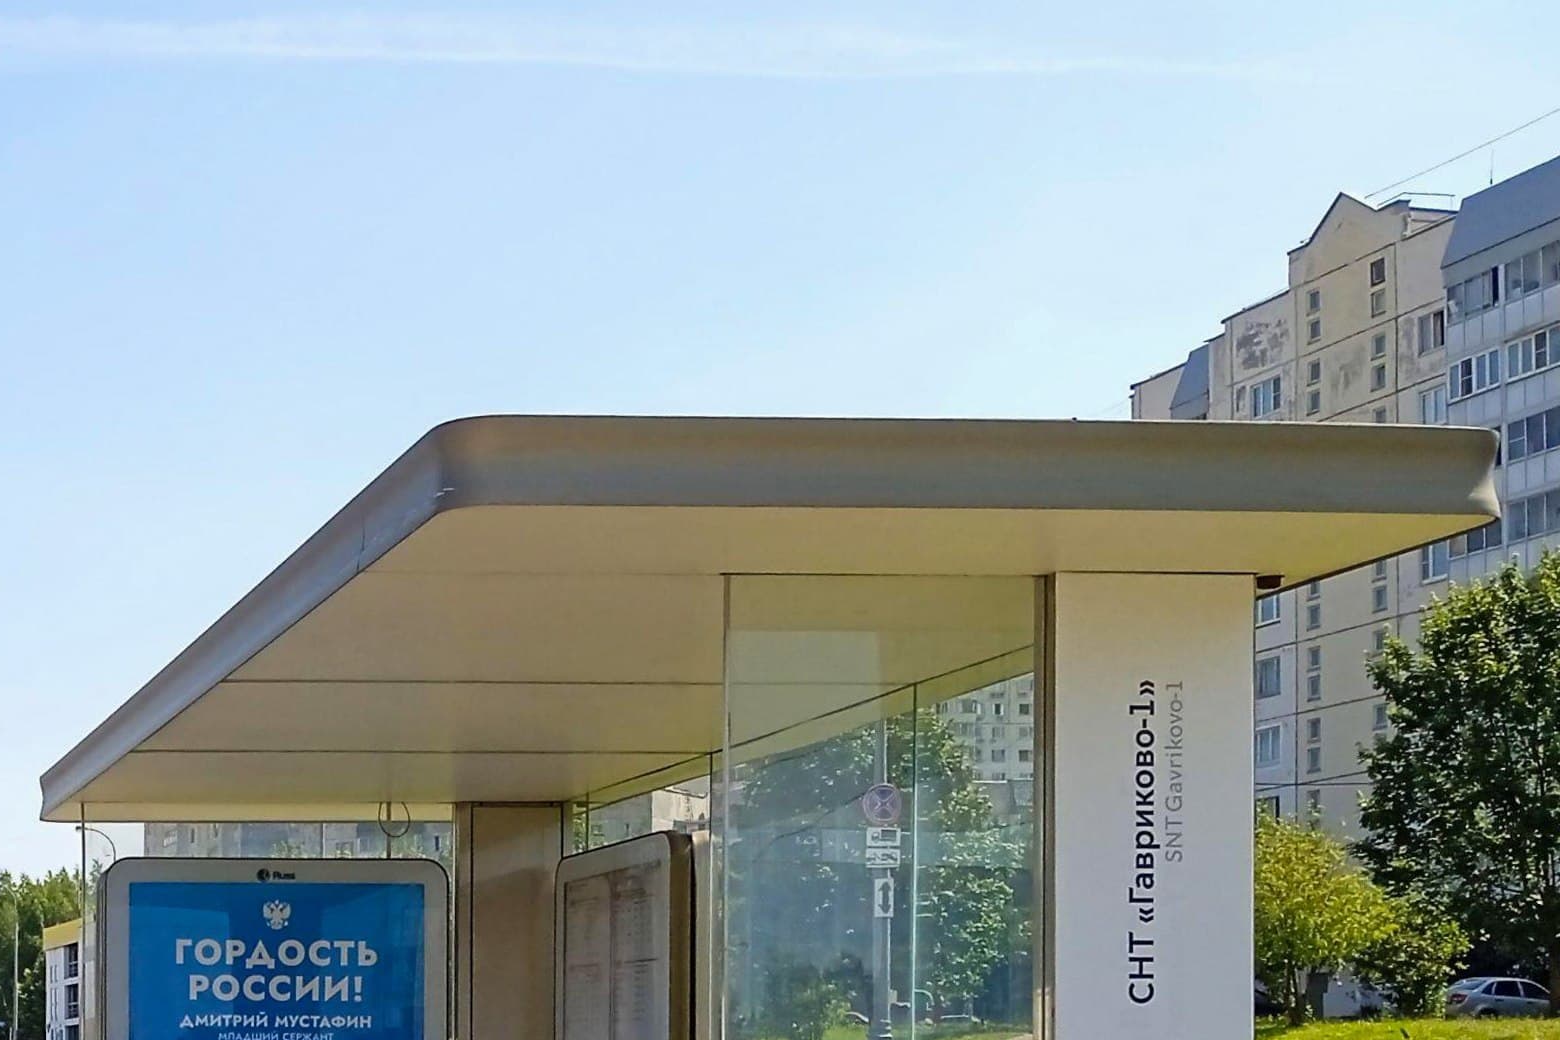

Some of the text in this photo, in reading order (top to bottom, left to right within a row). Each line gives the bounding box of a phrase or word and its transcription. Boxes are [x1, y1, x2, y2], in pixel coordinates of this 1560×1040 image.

[1164, 679, 1184, 863] SNT Gavrikovo-1
[1127, 678, 1161, 924] «Гавриково-1»
[174, 937, 378, 969] ГОРДОСТЬ
[1127, 930, 1155, 1005] СНТ
[188, 973, 363, 1003] РОССИИ!
[179, 1011, 372, 1029] ДМИТРИЙ МУСТАФИН
